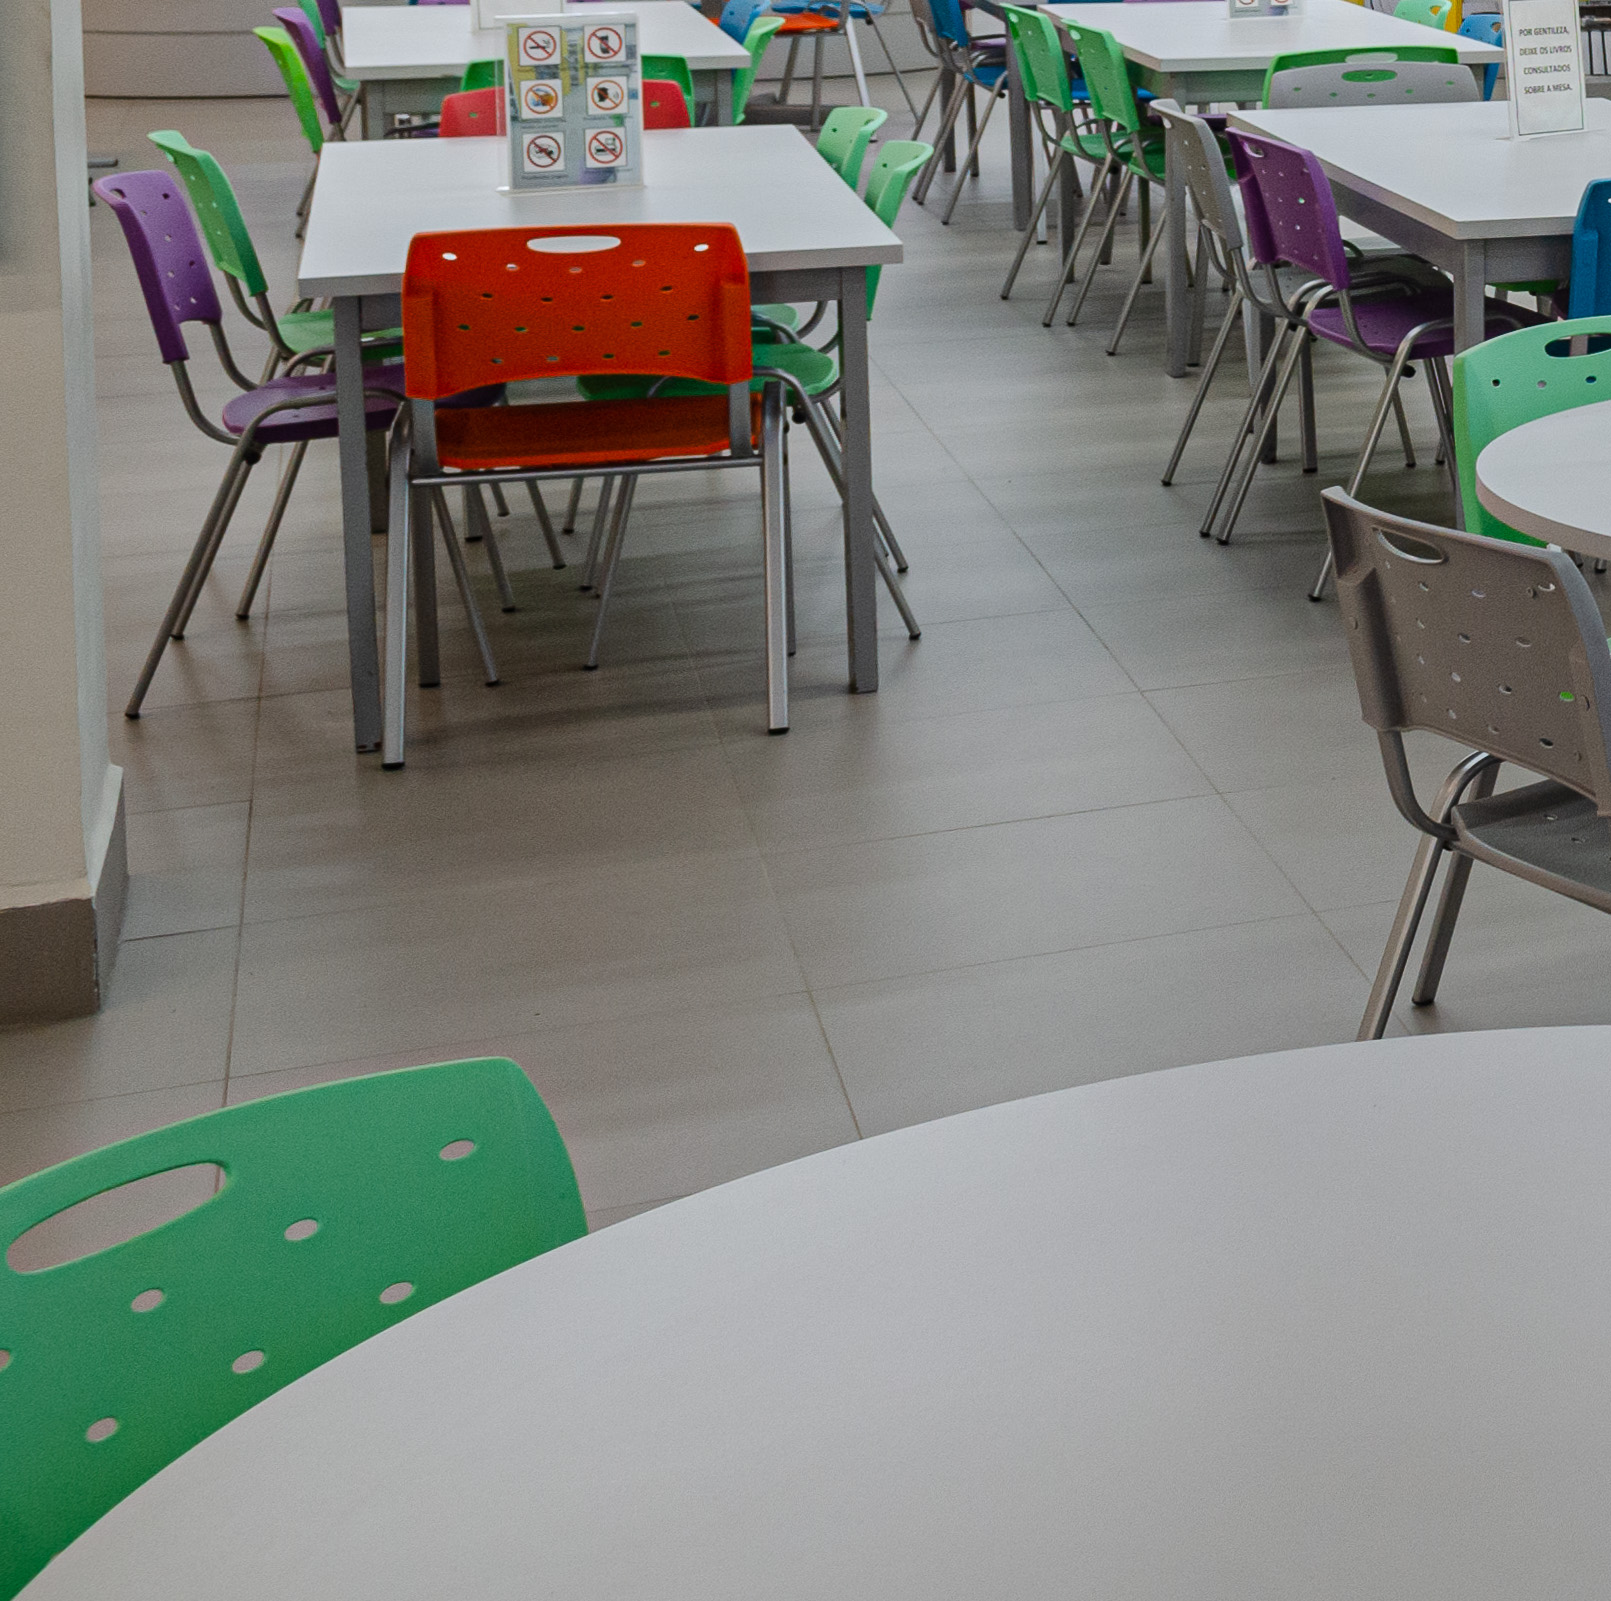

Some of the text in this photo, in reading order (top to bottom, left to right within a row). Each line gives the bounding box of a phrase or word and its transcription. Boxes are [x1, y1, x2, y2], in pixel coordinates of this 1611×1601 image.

[1519, 26, 1570, 37] POR GENTILEZA,
[1519, 45, 1572, 56] DEIXE OS LIVROS
[1523, 64, 1571, 75] CONSULTADOS
[1523, 85, 1545, 94] SOBRE
[1546, 84, 1552, 92] A
